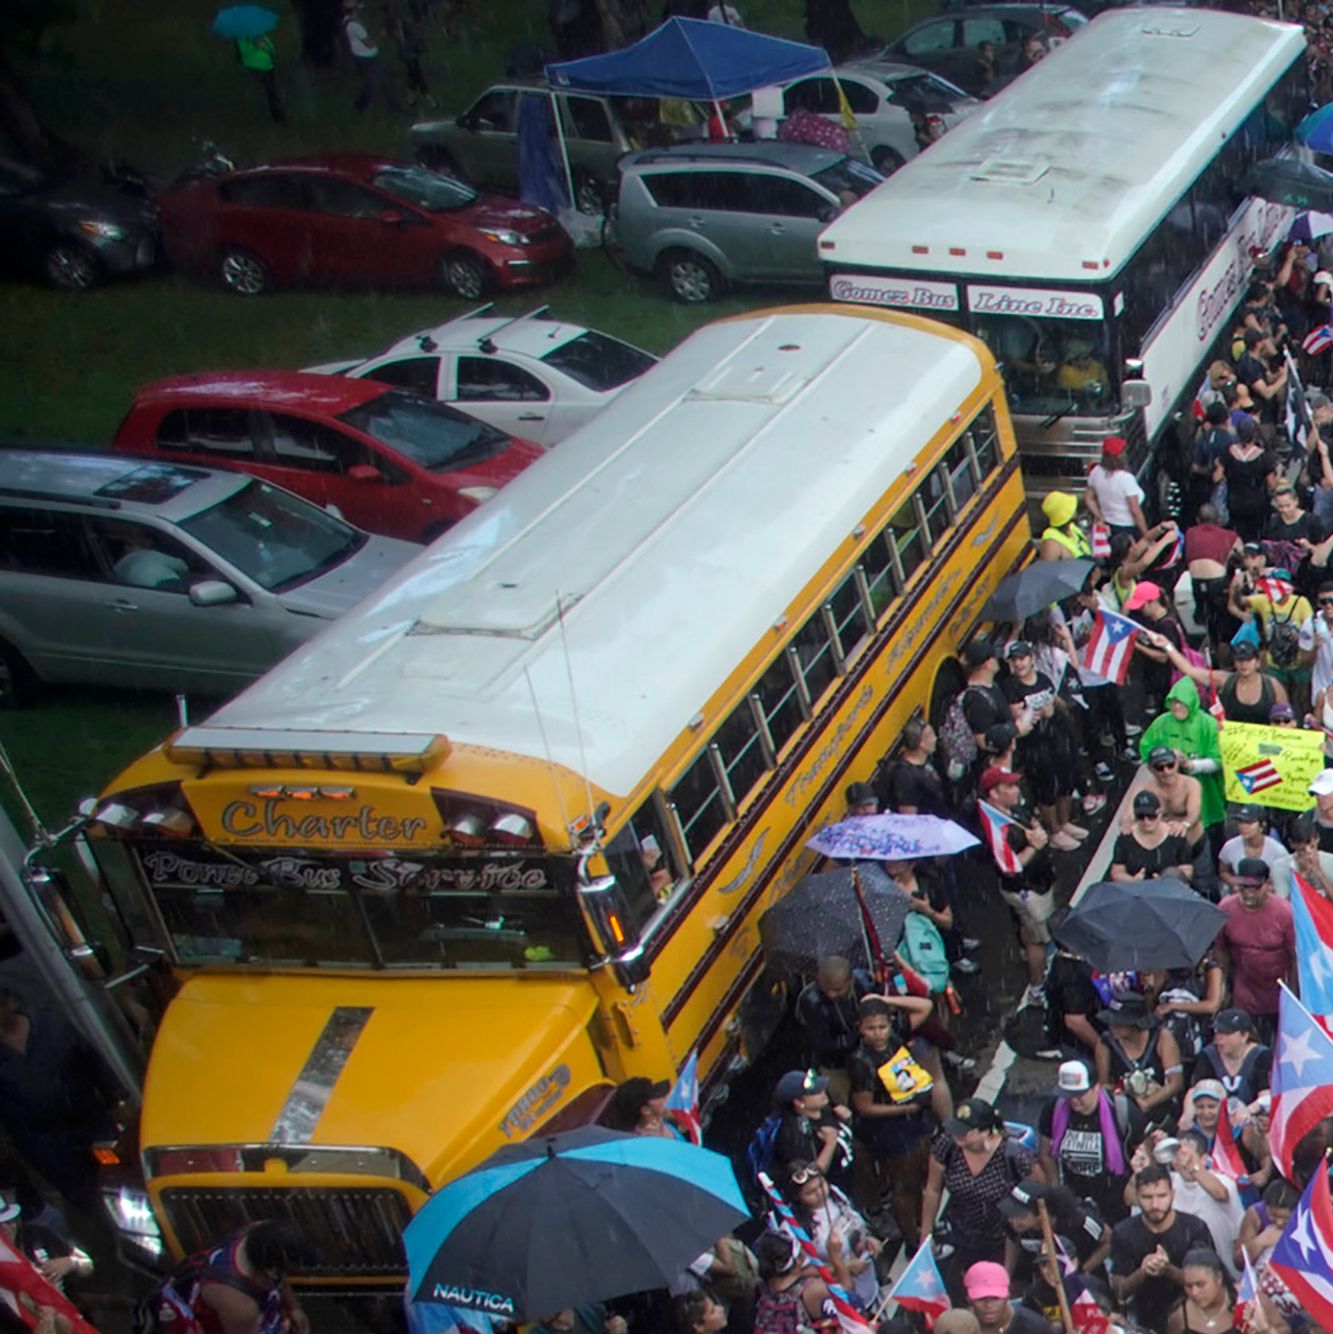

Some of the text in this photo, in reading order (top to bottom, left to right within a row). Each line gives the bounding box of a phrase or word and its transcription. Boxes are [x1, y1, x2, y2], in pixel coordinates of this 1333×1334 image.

[832, 280, 1101, 319] Gomez Bus Line Inc.
[222, 800, 429, 842] Charter
[260, 856, 343, 889] Bus
[433, 1283, 516, 1313] NAUTICA
